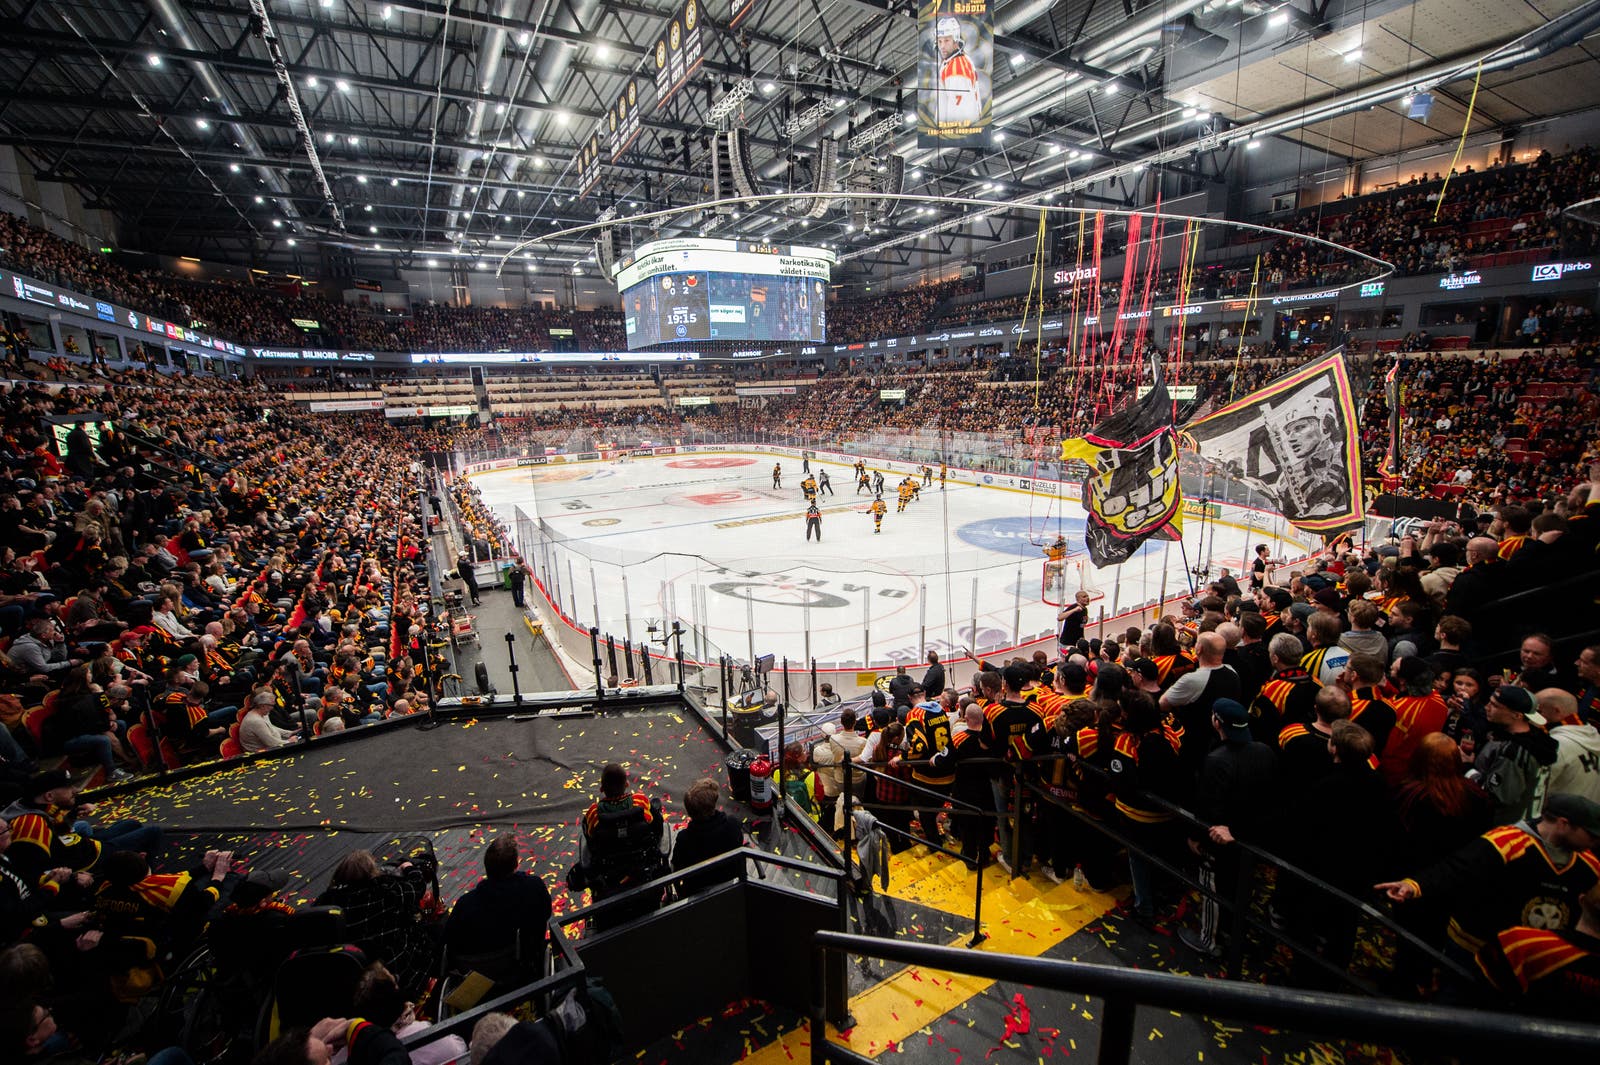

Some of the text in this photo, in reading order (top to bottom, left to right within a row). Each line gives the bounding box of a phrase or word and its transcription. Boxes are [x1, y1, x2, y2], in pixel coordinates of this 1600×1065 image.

[955, 95, 962, 106] 7
[780, 258, 814, 268] Narkotika
[780, 266, 802, 275] våldet
[1536, 262, 1592, 276] ICA Järbo
[1053, 267, 1098, 284] Skybar
[670, 286, 689, 295] 0 2
[667, 313, 697, 324] 19:15
[934, 726, 949, 752] 6
